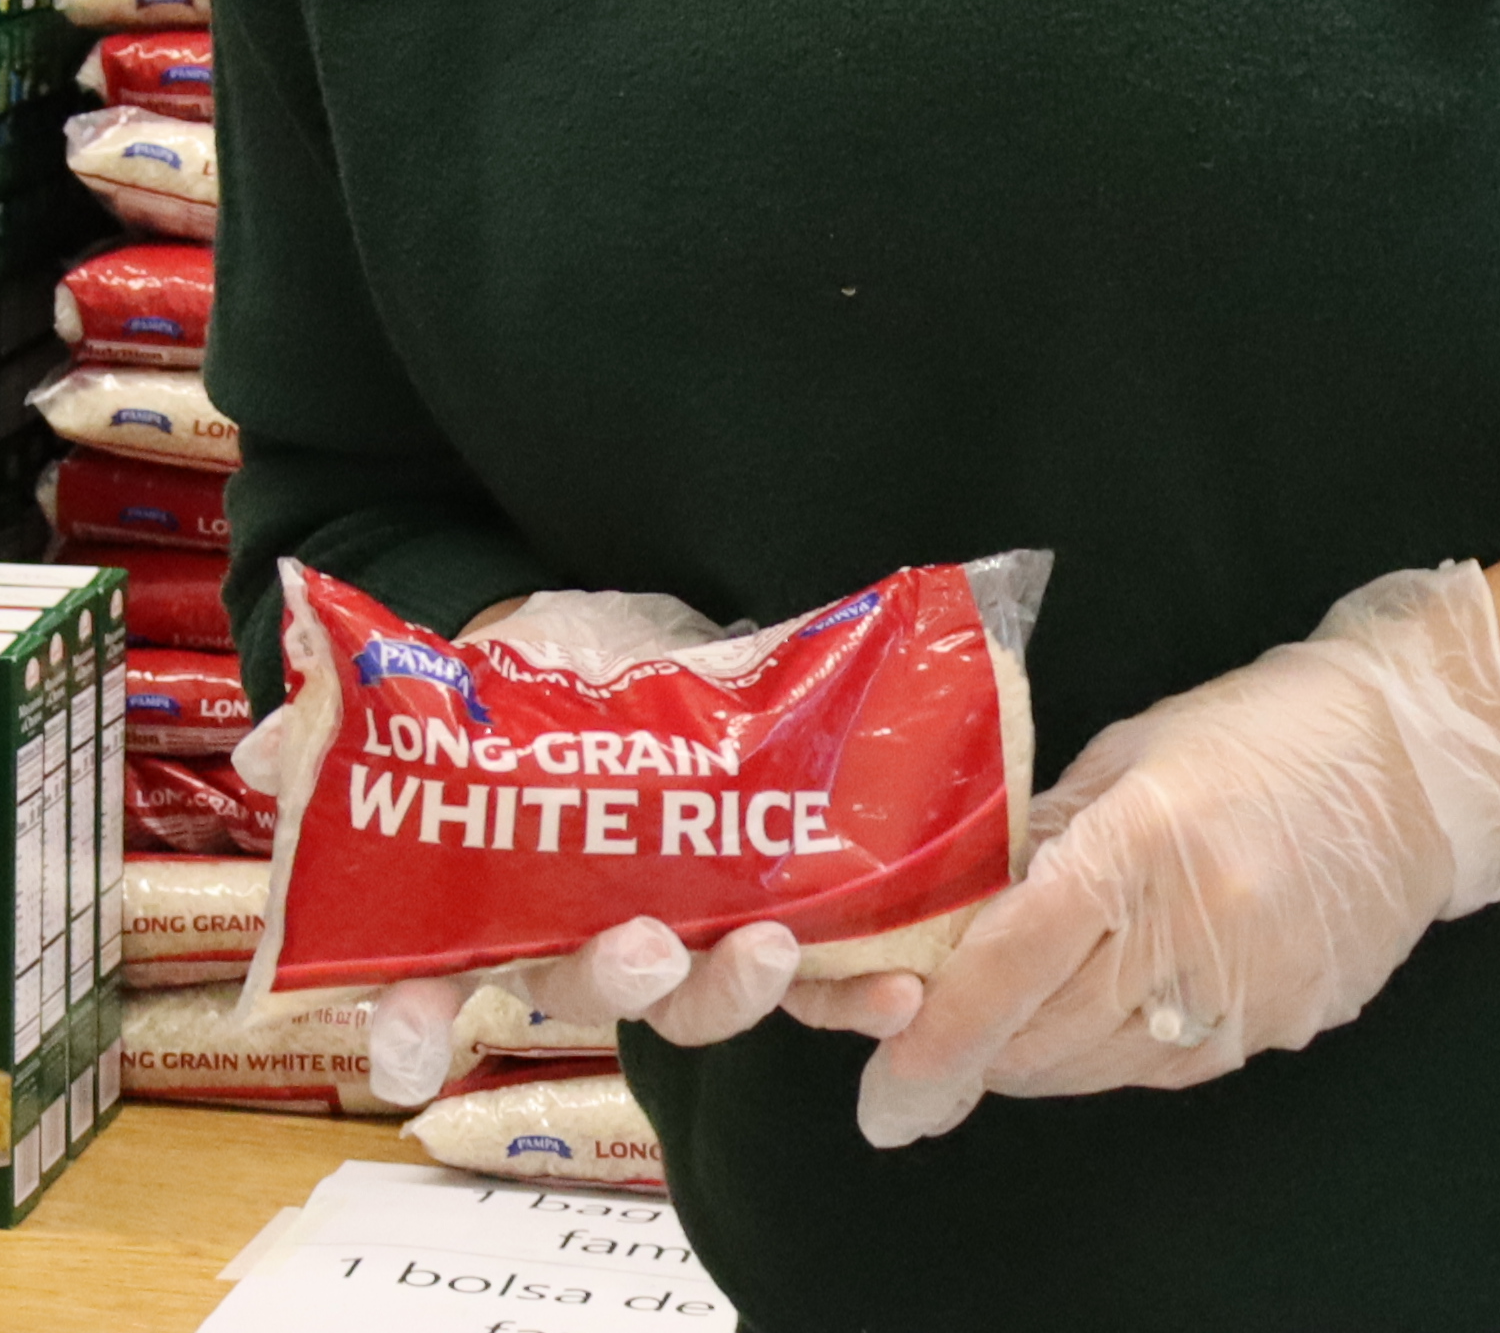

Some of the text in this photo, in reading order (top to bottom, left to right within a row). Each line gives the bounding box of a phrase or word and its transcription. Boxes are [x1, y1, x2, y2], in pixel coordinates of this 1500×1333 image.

[193, 419, 239, 440] LON
[197, 516, 231, 535] LO
[379, 639, 472, 699] PAMPA
[200, 698, 250, 719] LON
[366, 706, 741, 777] LONG GRAIN
[349, 763, 843, 857] WHITE RICE
[120, 1051, 370, 1074] NG GRAIN WHITE RIC
[516, 1136, 562, 1153] PAMPA
[529, 1193, 662, 1224] bag
[557, 1228, 692, 1264] fam
[340, 1256, 716, 1317] 1 bolsa de
